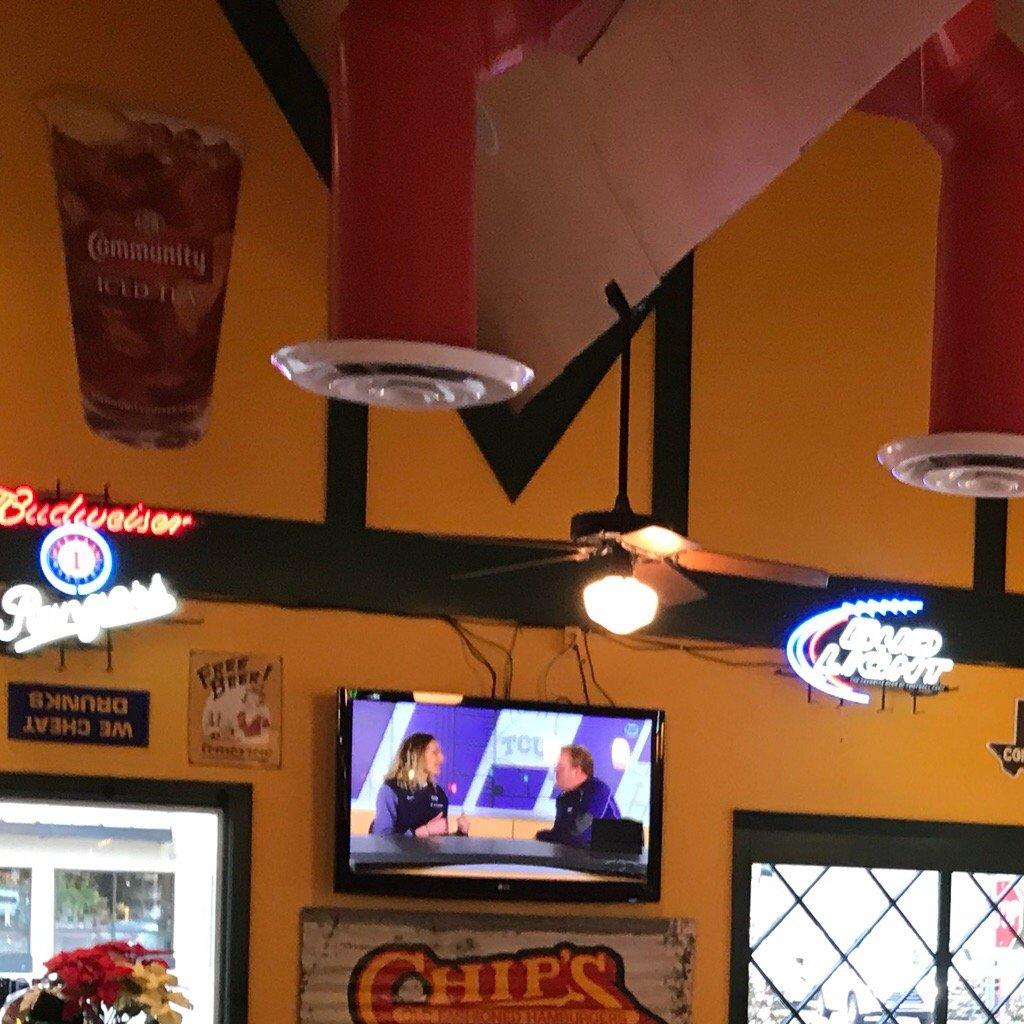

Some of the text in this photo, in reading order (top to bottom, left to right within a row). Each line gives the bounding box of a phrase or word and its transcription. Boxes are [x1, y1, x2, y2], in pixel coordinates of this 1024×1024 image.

[88, 230, 206, 276] Community
[0, 485, 193, 536] Budweiser
[839, 616, 943, 658] BUD
[813, 642, 955, 685] LIGHT
[28, 689, 129, 715] DRUNKS
[22, 715, 134, 740] WE CHEAT
